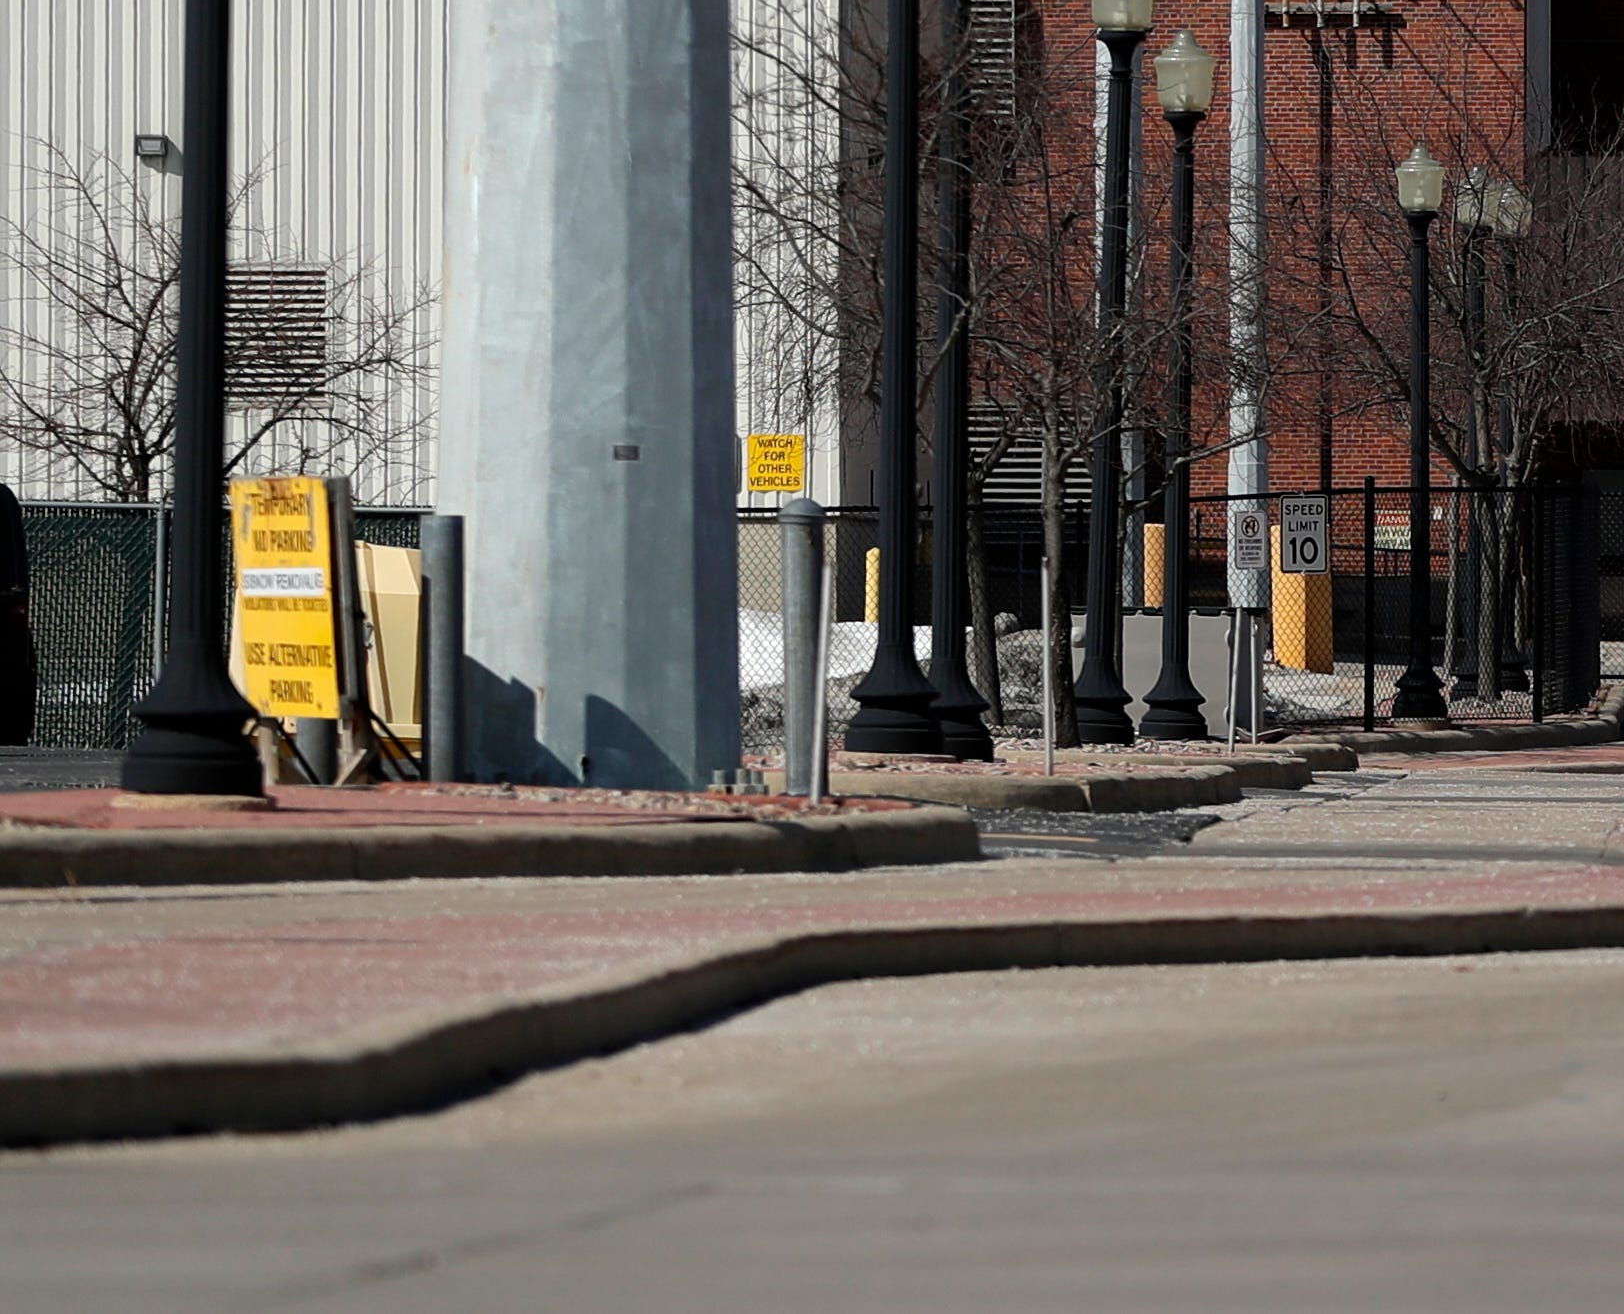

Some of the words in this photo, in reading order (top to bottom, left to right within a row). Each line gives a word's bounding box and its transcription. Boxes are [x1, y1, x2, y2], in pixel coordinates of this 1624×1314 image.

[757, 438, 793, 448] WATCH
[764, 451, 785, 462] FOR
[758, 464, 793, 474] OTHER
[750, 476, 801, 487] VEHICLES
[1284, 504, 1324, 516] SPEED
[1288, 520, 1320, 533] LIMIT
[270, 530, 314, 554] PARKING
[1289, 536, 1319, 565] 10
[268, 643, 333, 668] ALTERNATIVE
[269, 679, 314, 704] PARKING
